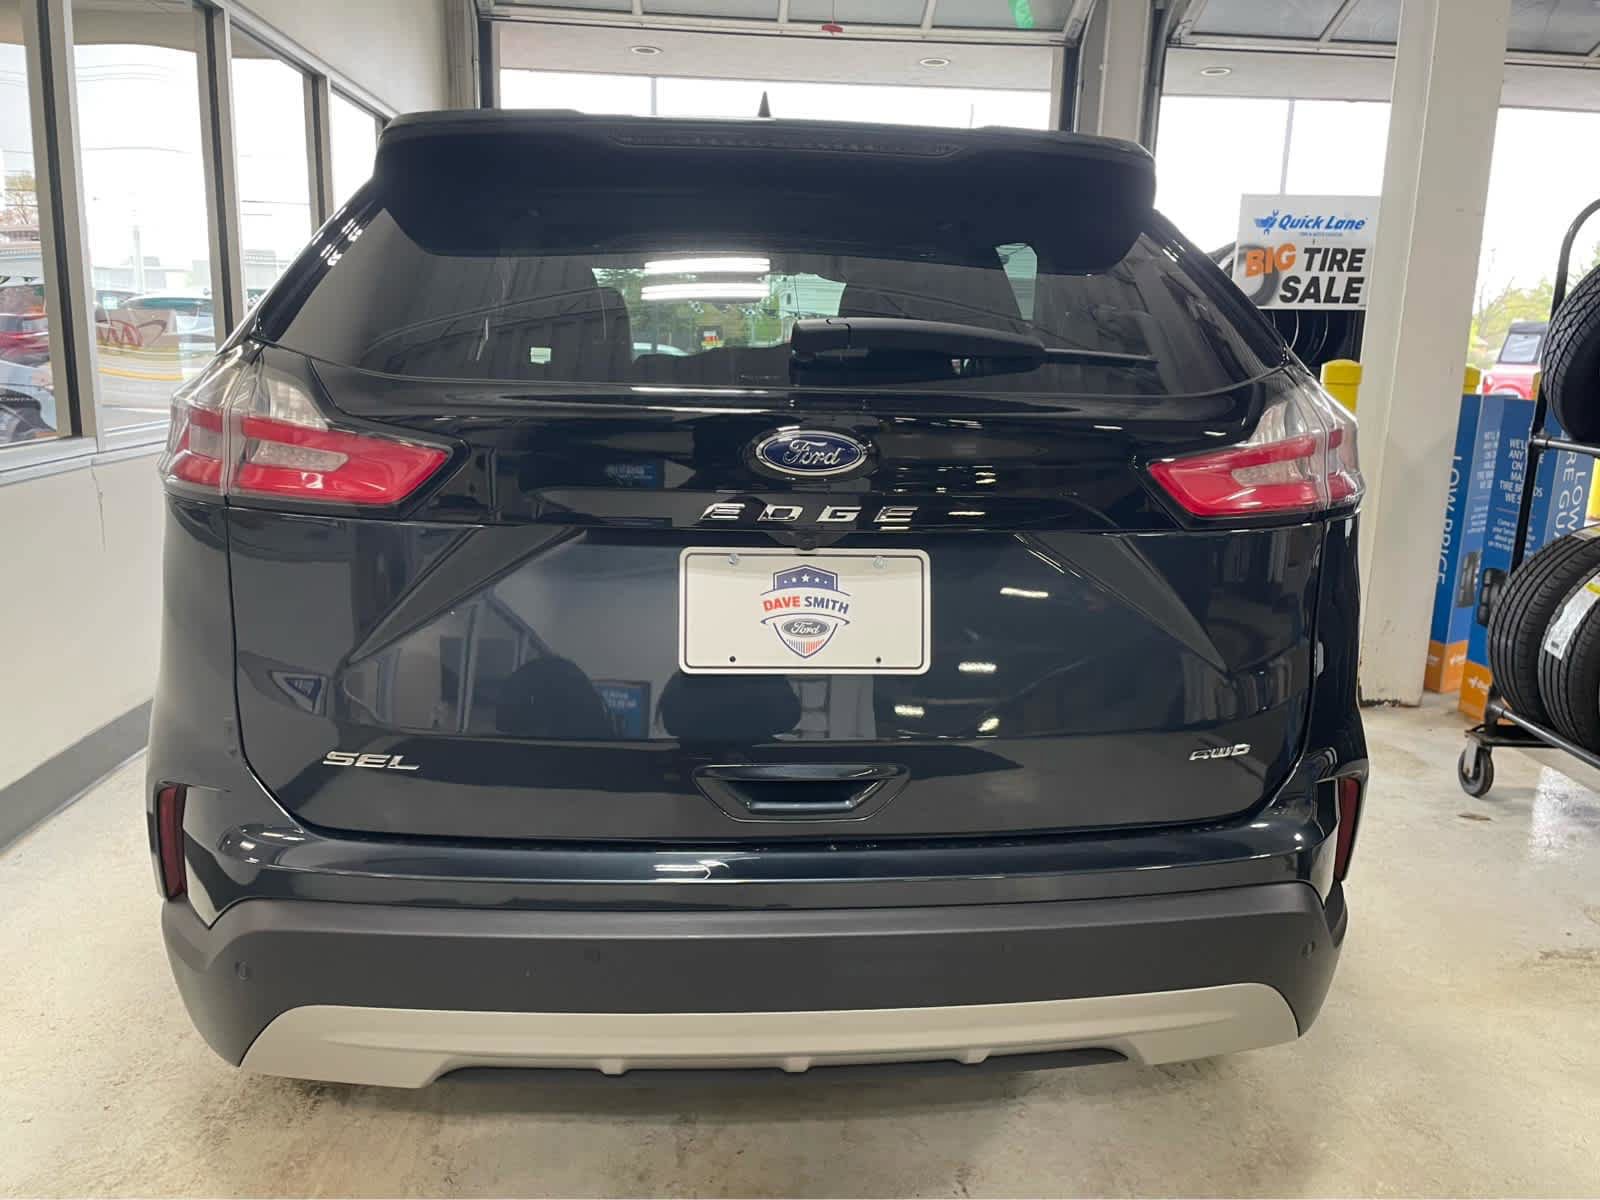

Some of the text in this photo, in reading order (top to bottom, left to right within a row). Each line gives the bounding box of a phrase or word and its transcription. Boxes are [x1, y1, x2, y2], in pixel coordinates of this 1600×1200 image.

[1278, 214, 1366, 230] Quick Lane
[1244, 242, 1367, 278] BIG TIRE
[1279, 275, 1366, 304] SALE
[782, 439, 842, 466] Ford
[699, 502, 919, 523] EDGE
[762, 595, 850, 615] DAVE SMITH
[789, 619, 823, 635] Ford
[322, 751, 420, 770] SEL
[1188, 743, 1252, 761] AWD
